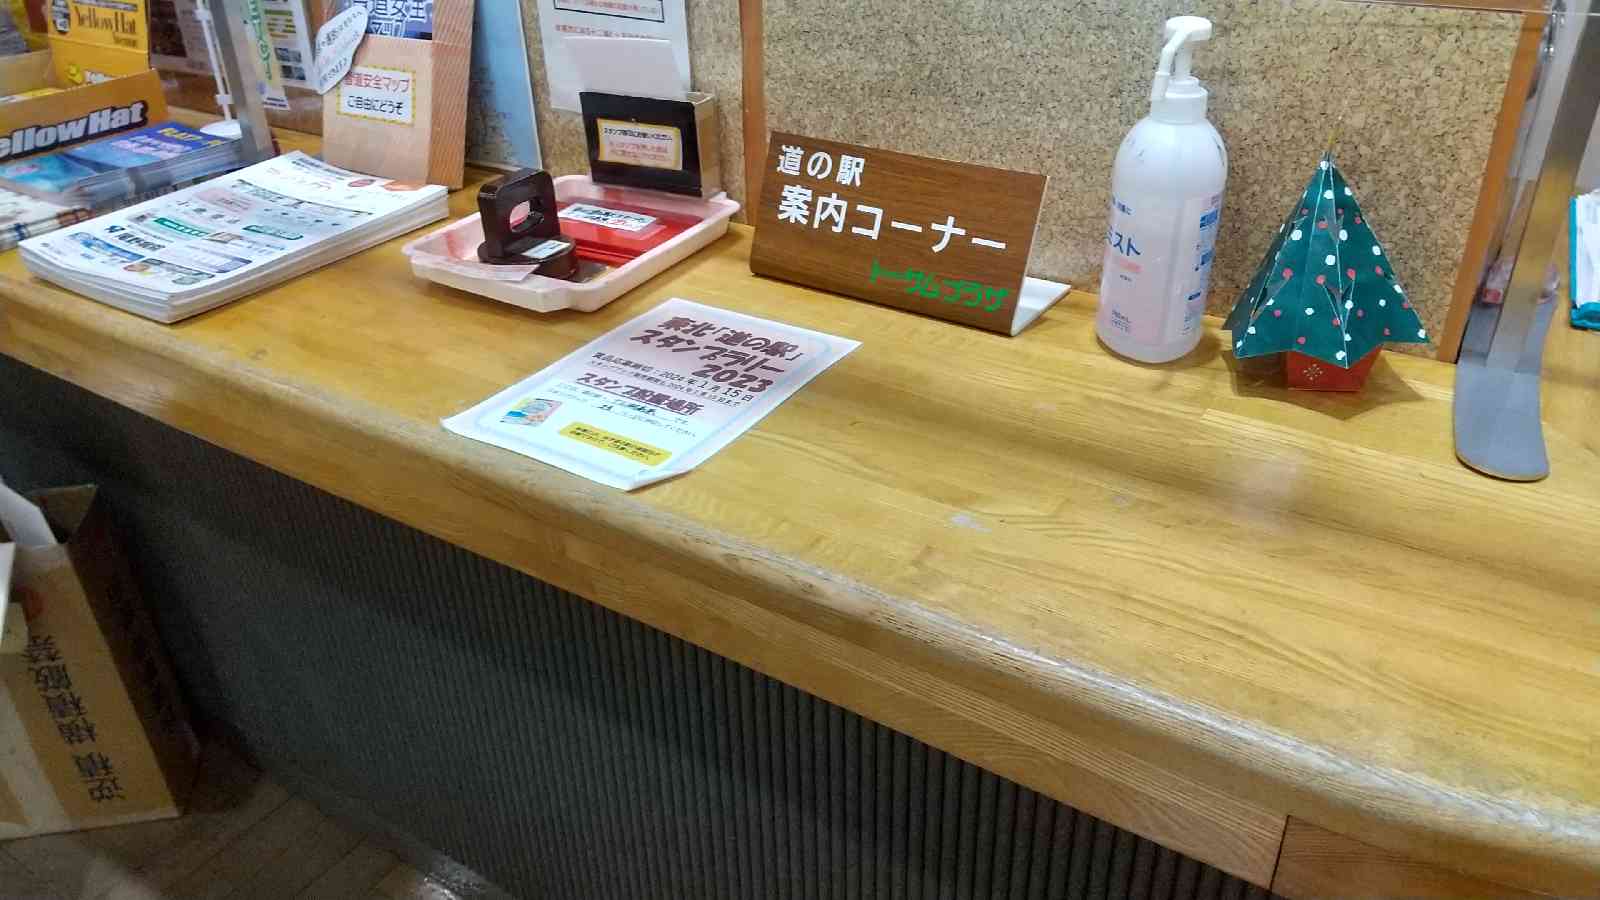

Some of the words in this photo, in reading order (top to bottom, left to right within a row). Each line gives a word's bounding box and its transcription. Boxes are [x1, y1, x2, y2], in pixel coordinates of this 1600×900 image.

[776, 144, 866, 188] 道の駅
[776, 184, 1008, 254] 案内コーナー
[629, 328, 786, 374] スタンプラリー
[691, 364, 775, 394] 2023
